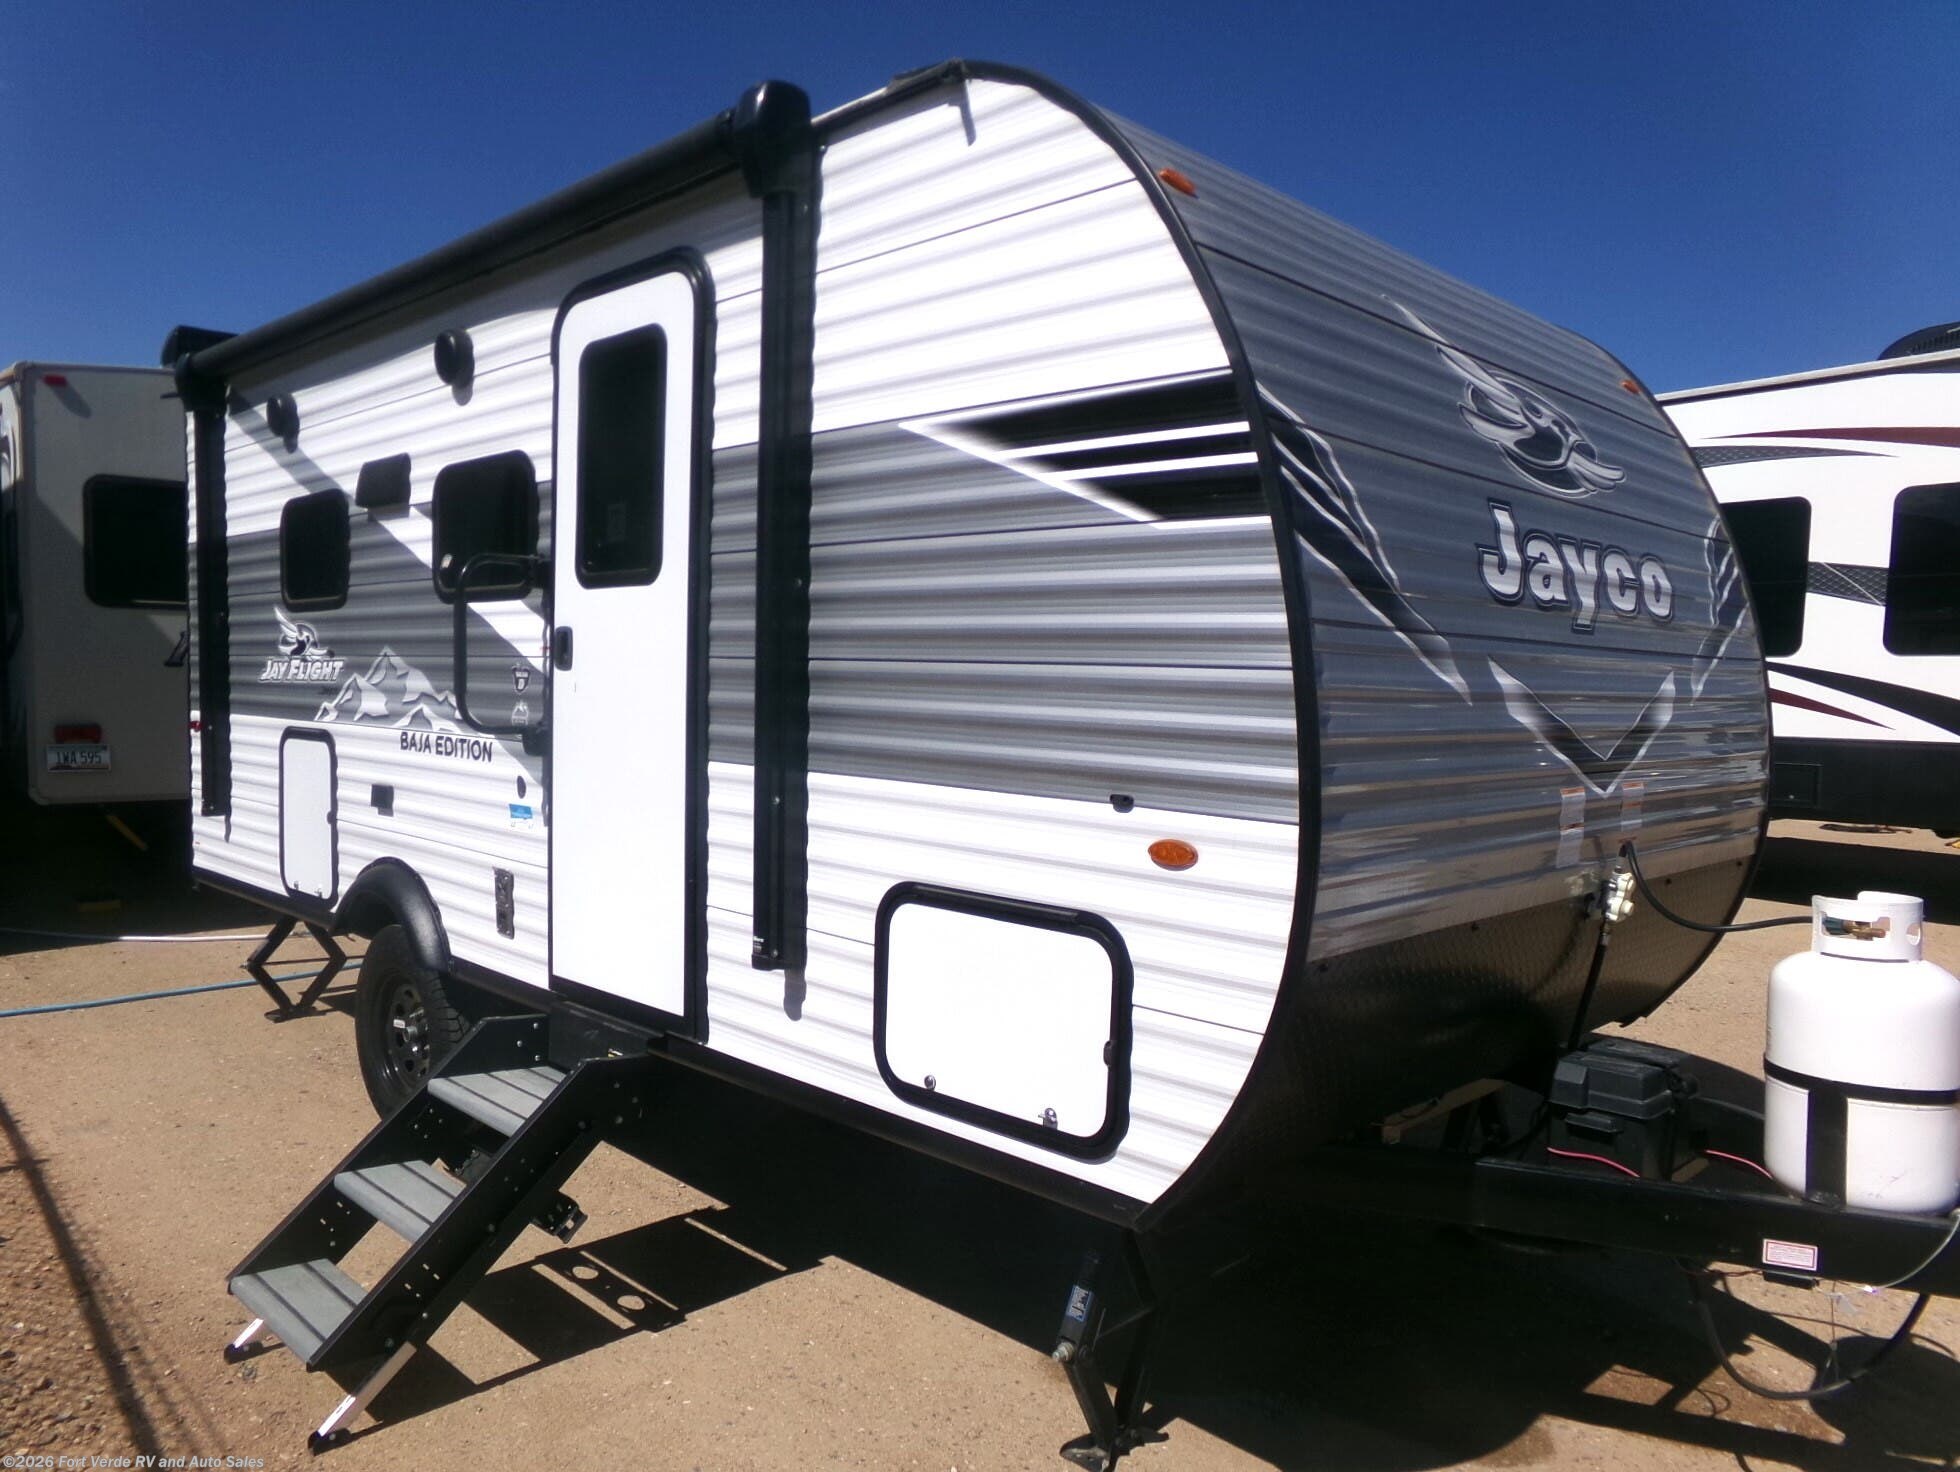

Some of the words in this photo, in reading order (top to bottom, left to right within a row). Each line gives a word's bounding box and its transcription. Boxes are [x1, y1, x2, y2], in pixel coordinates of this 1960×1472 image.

[1477, 499, 1674, 633] Jayco
[259, 659, 290, 681] JAY
[287, 658, 344, 682] FLIGHT
[400, 731, 432, 754] BAJA
[435, 735, 493, 762] EDITION
